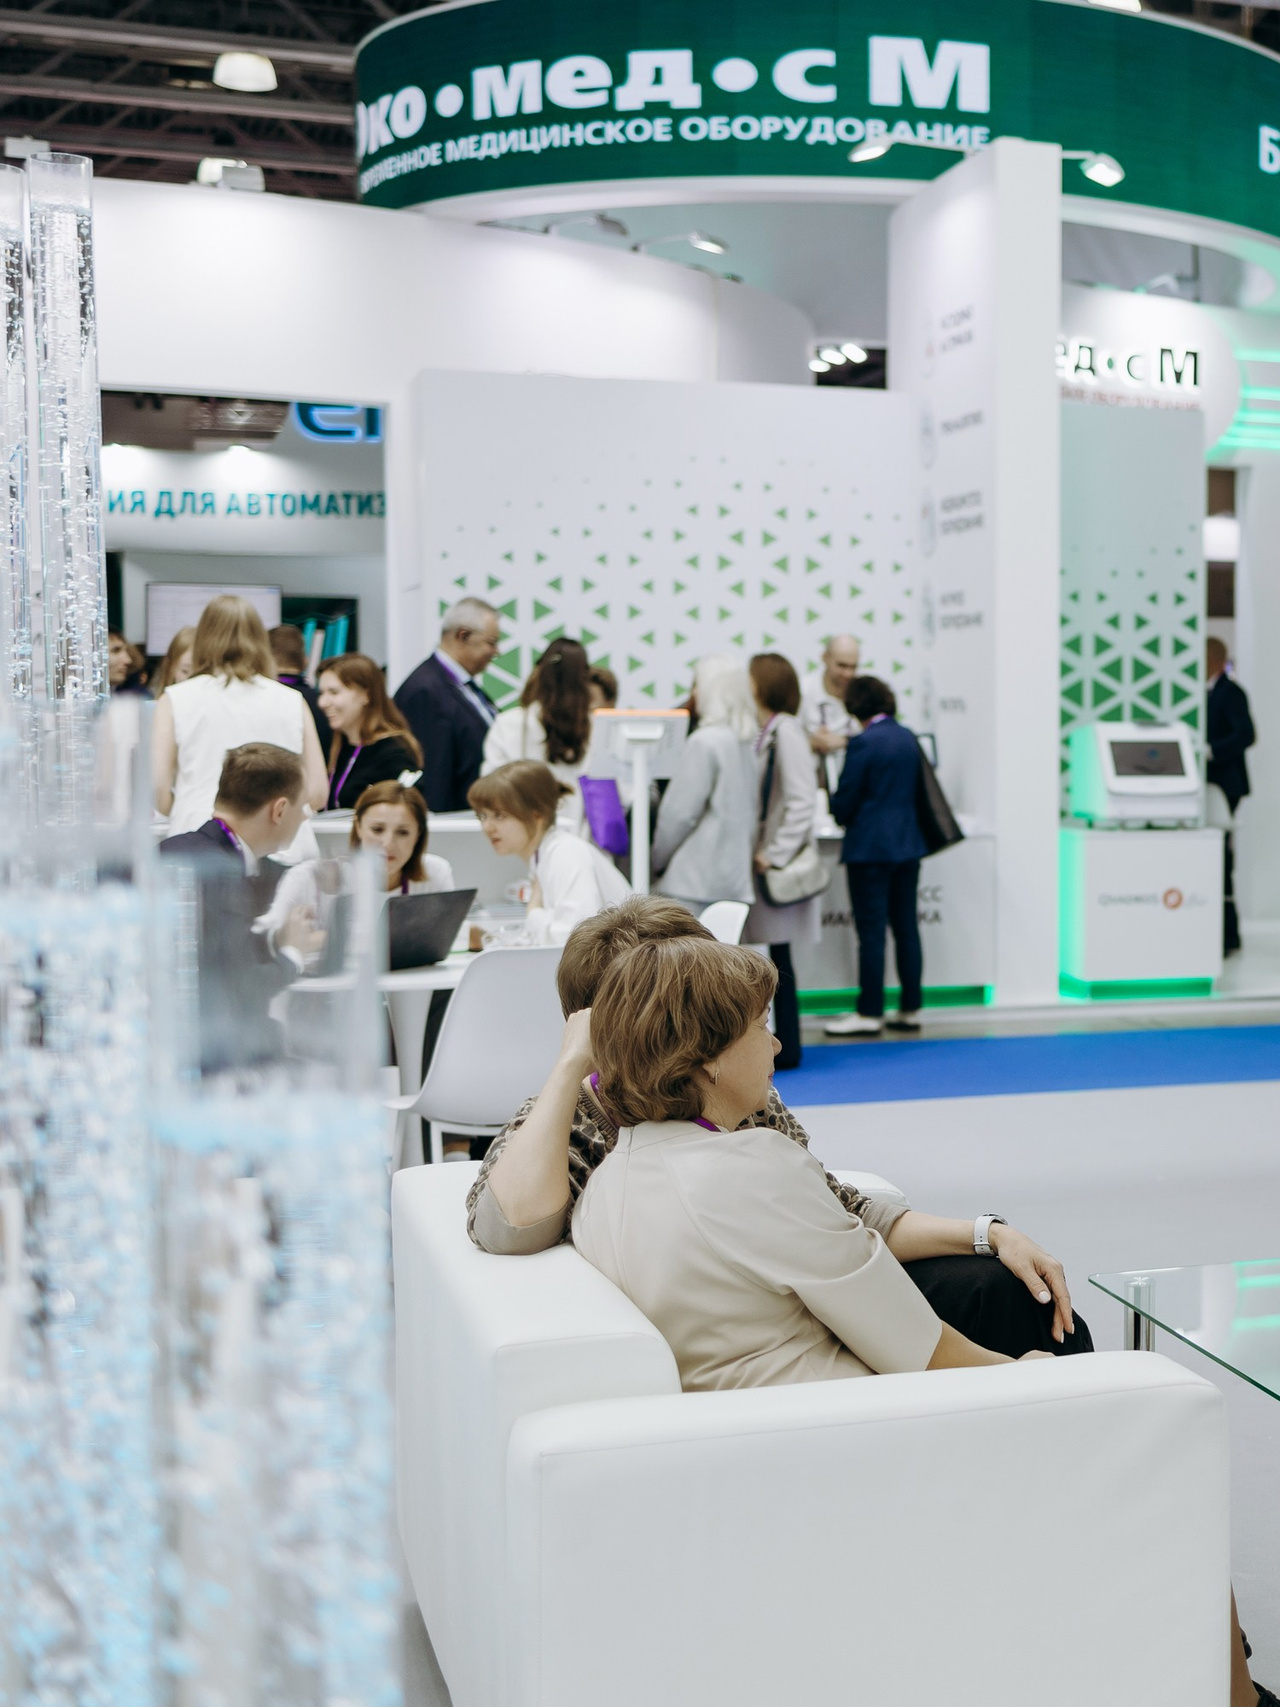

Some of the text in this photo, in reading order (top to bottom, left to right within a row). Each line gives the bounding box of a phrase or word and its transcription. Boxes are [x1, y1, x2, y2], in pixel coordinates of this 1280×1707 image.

[445, 117, 673, 164] МЕДИЦИНСКОЕ
[679, 115, 991, 150] ОБОРУДОВАНИЕ
[108, 489, 145, 514] ИЯ
[154, 490, 216, 519] ДЛЯ
